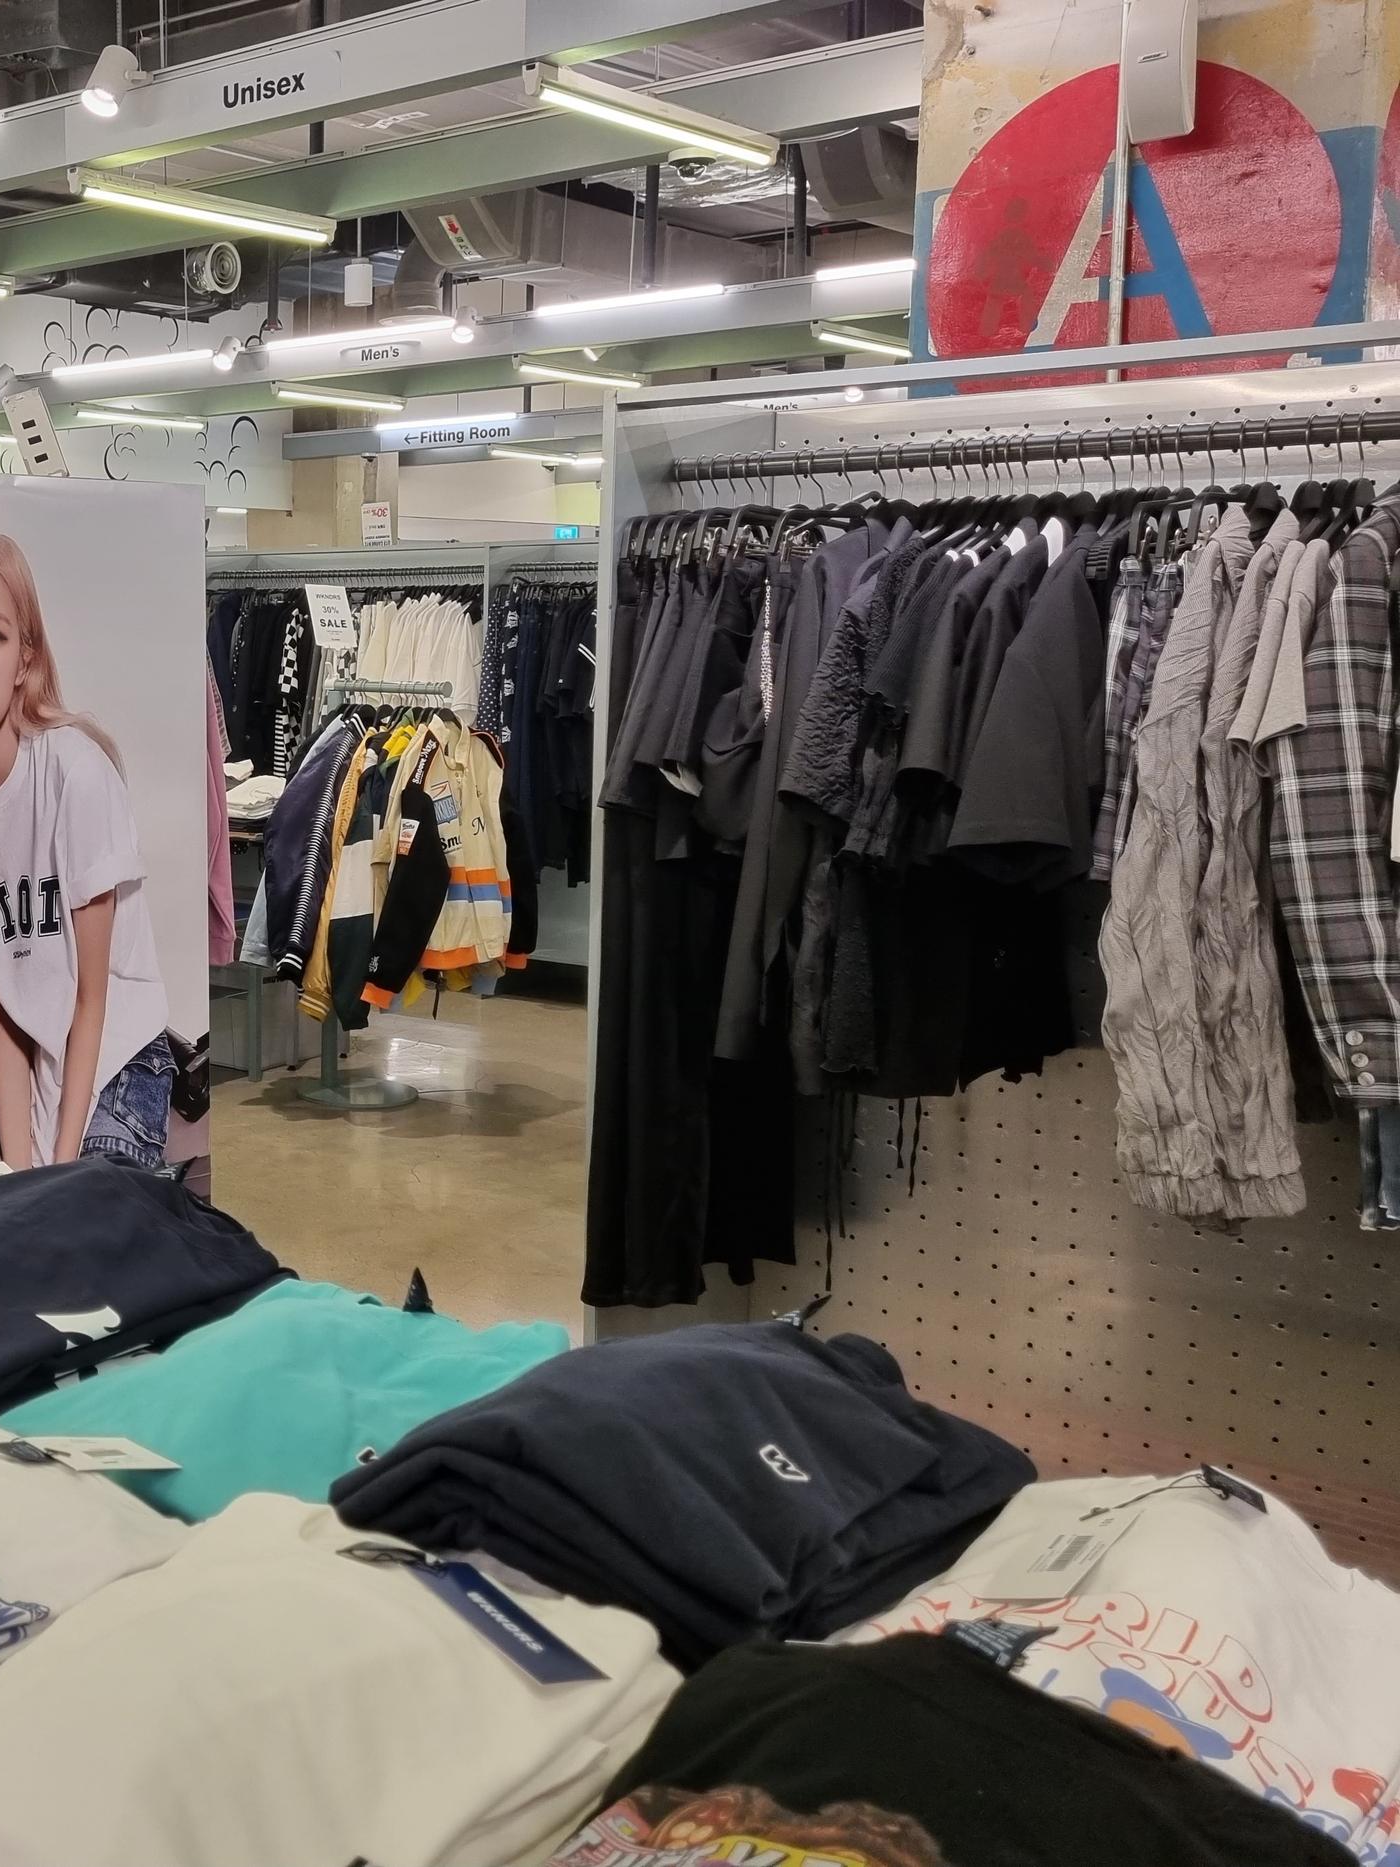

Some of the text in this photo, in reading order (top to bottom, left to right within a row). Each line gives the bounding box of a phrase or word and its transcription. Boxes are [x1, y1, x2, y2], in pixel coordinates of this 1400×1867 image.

[222, 68, 305, 109] Unisex
[361, 345, 400, 361] Men's
[763, 401, 799, 411] Men's
[420, 426, 511, 444] Fitting Room
[322, 606, 339, 614] 30%
[319, 618, 347, 629] SALE
